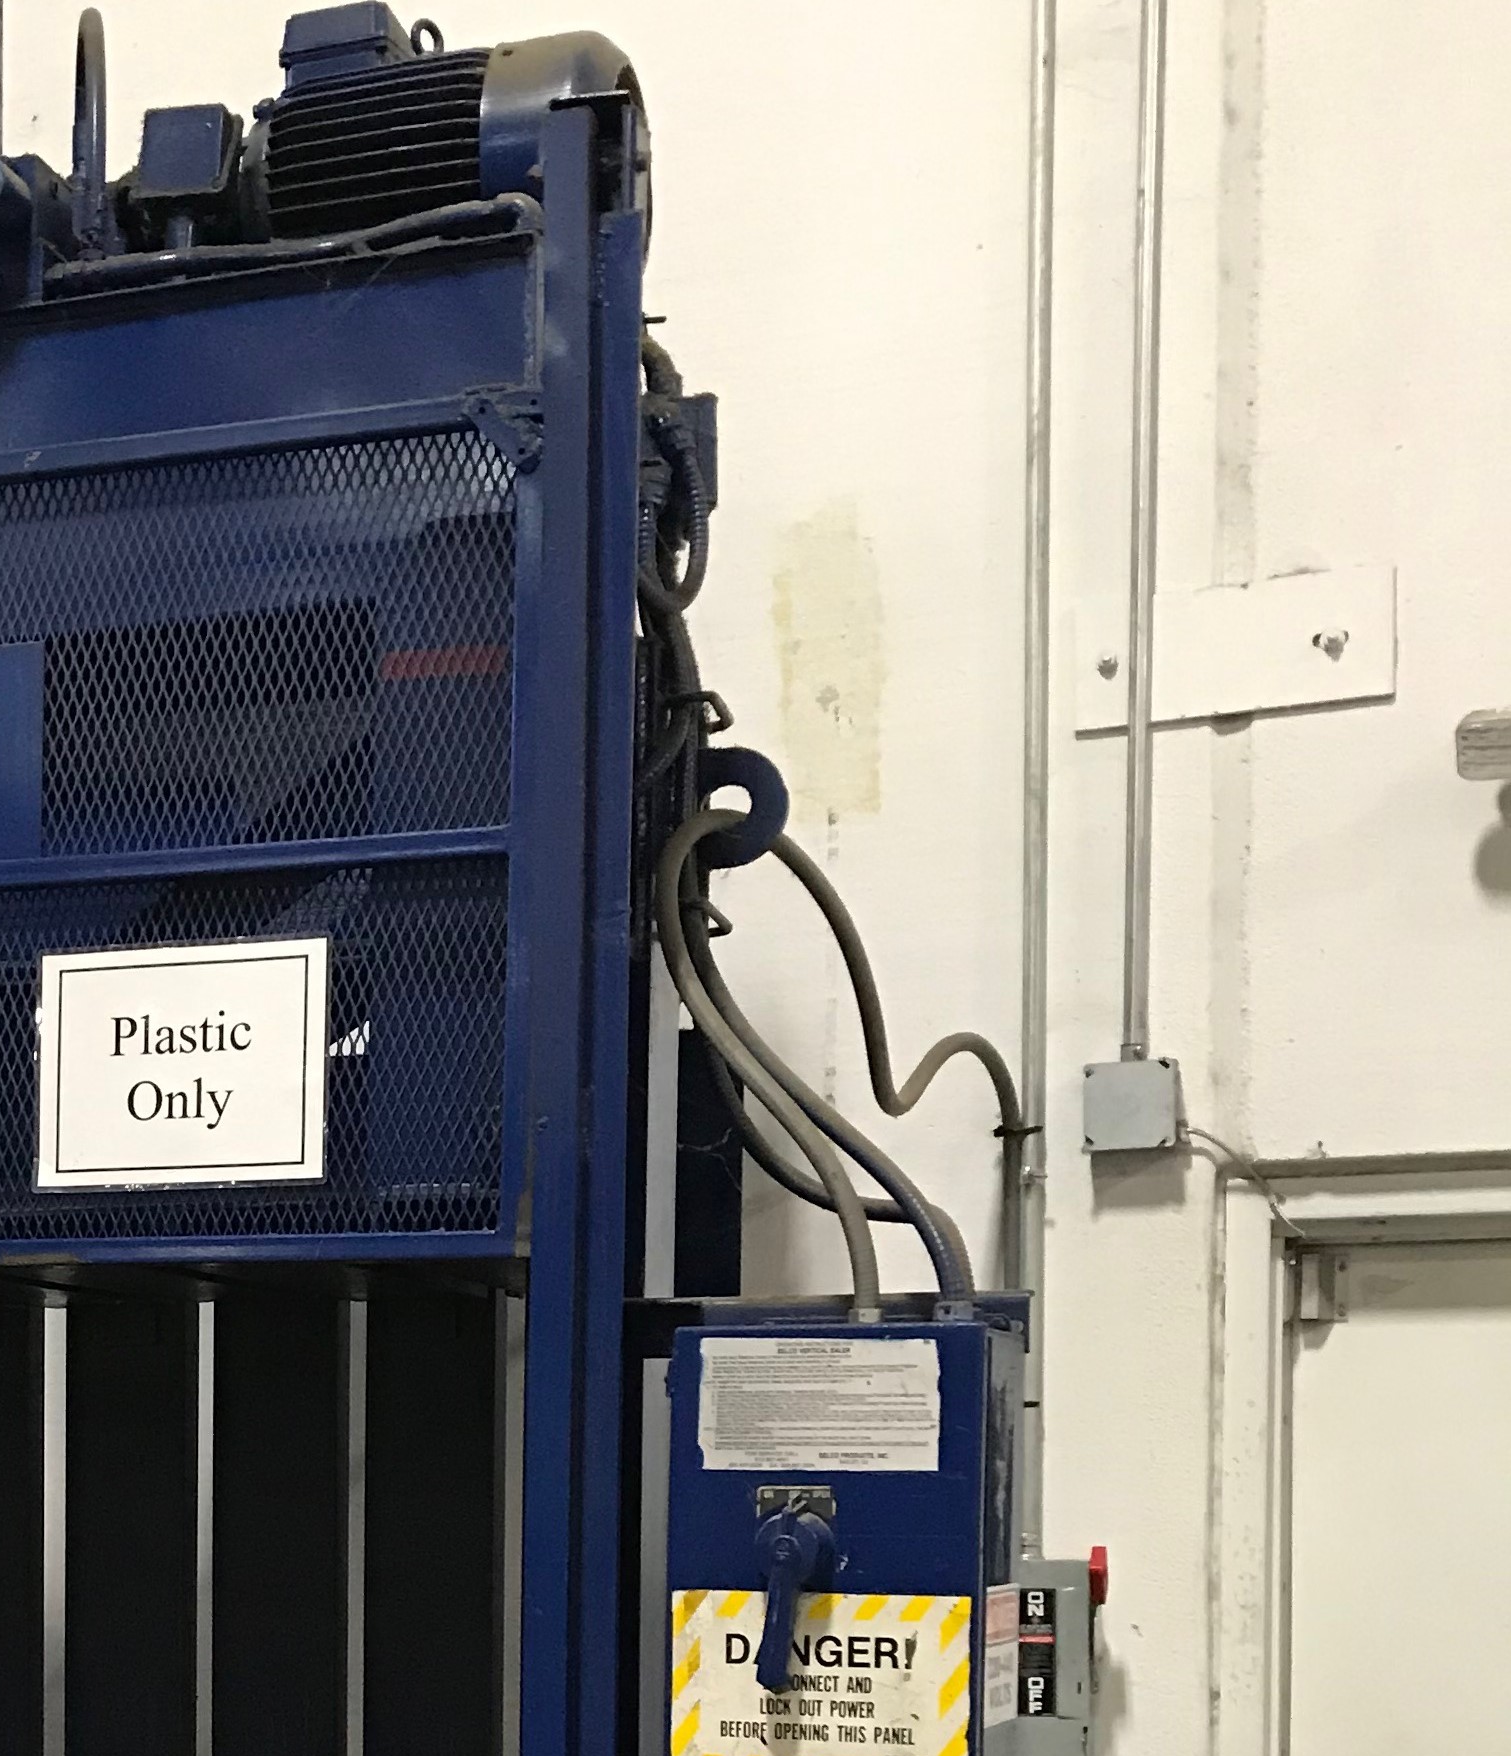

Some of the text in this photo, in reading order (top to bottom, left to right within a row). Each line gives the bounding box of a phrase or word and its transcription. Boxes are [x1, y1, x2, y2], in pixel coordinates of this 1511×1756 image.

[109, 1009, 253, 1057] Plastic
[127, 1077, 234, 1130] Only
[1027, 1591, 1044, 1617] ON
[724, 1632, 918, 1681] DNGER!
[846, 1677, 872, 1694] AND
[1028, 1676, 1044, 1714] OFF
[759, 1697, 875, 1719] LOCK OUT POWER
[720, 1720, 916, 1746] BEFORE OPENING THIS PANEL
